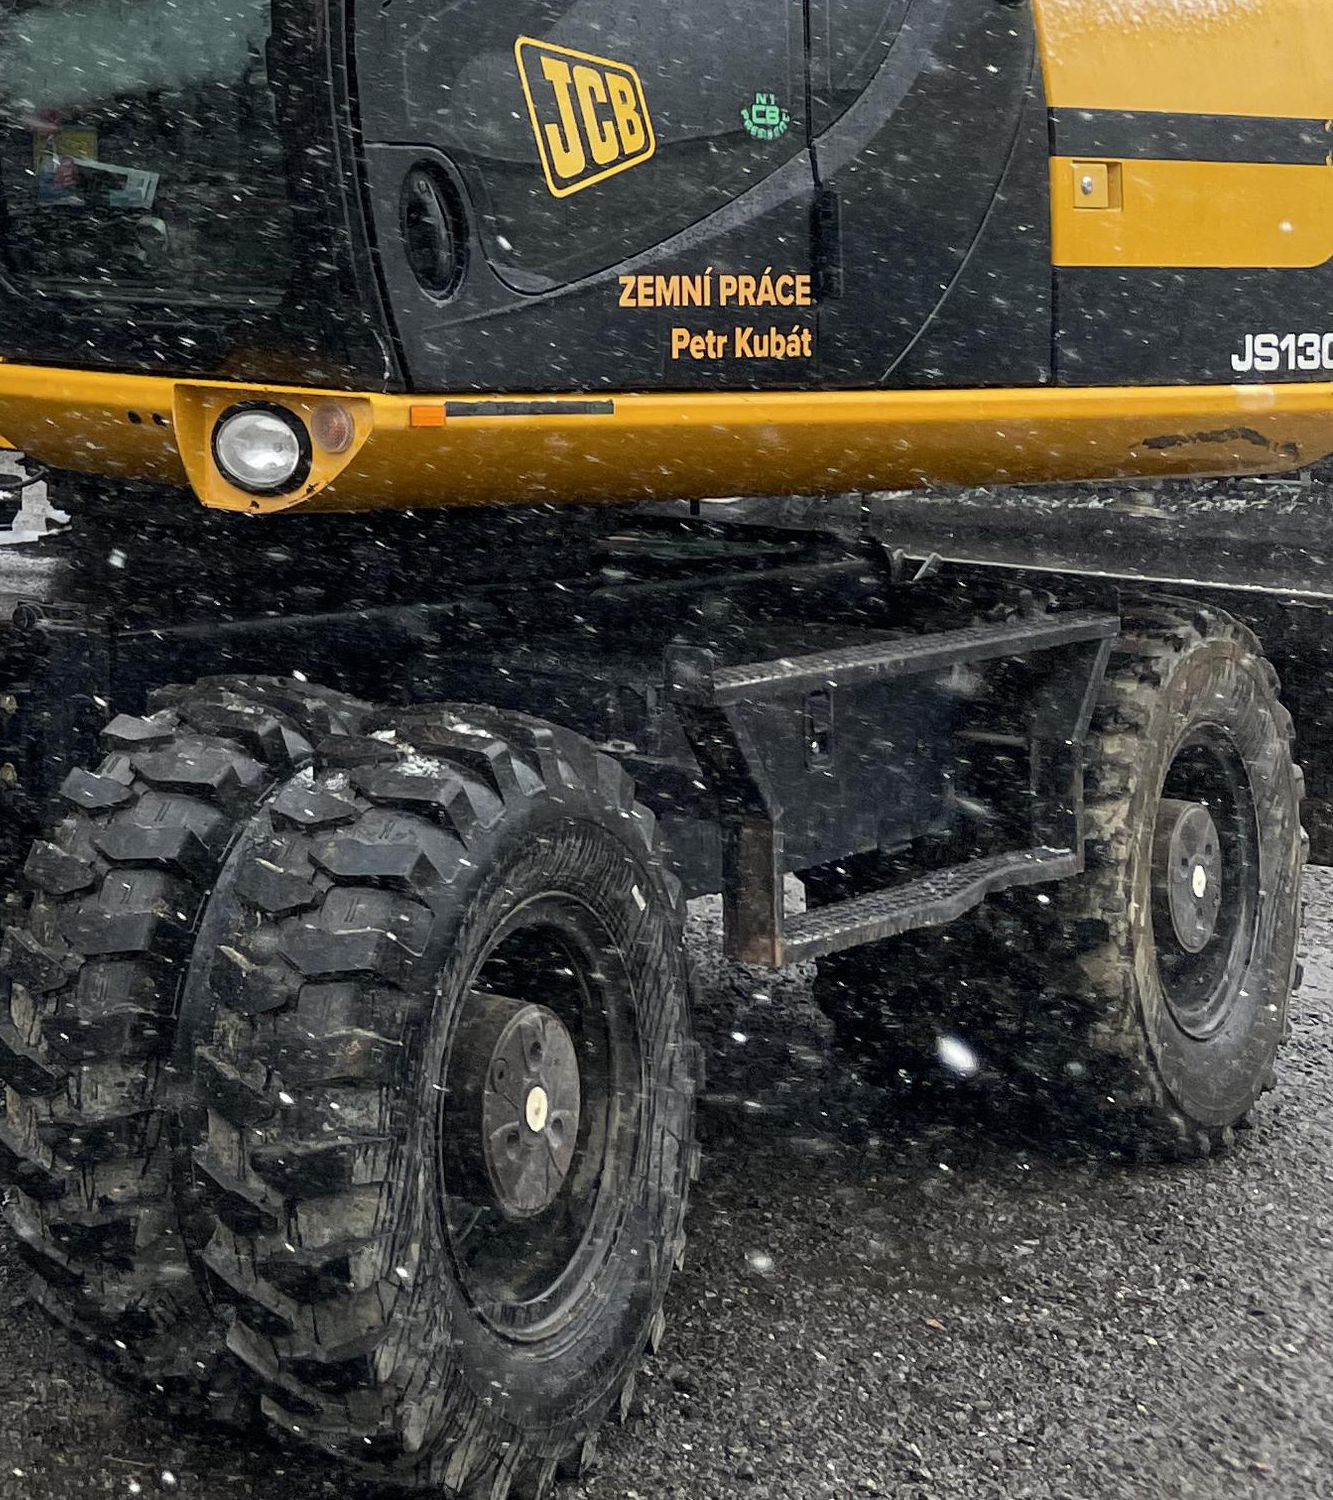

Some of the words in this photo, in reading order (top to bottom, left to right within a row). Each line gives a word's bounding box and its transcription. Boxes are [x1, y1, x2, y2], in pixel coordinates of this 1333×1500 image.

[539, 54, 646, 180] JCB
[618, 266, 713, 307] ZEMNÍ
[719, 266, 812, 306] PRÁCE
[670, 327, 728, 360] Petr
[734, 324, 813, 359] Kubát
